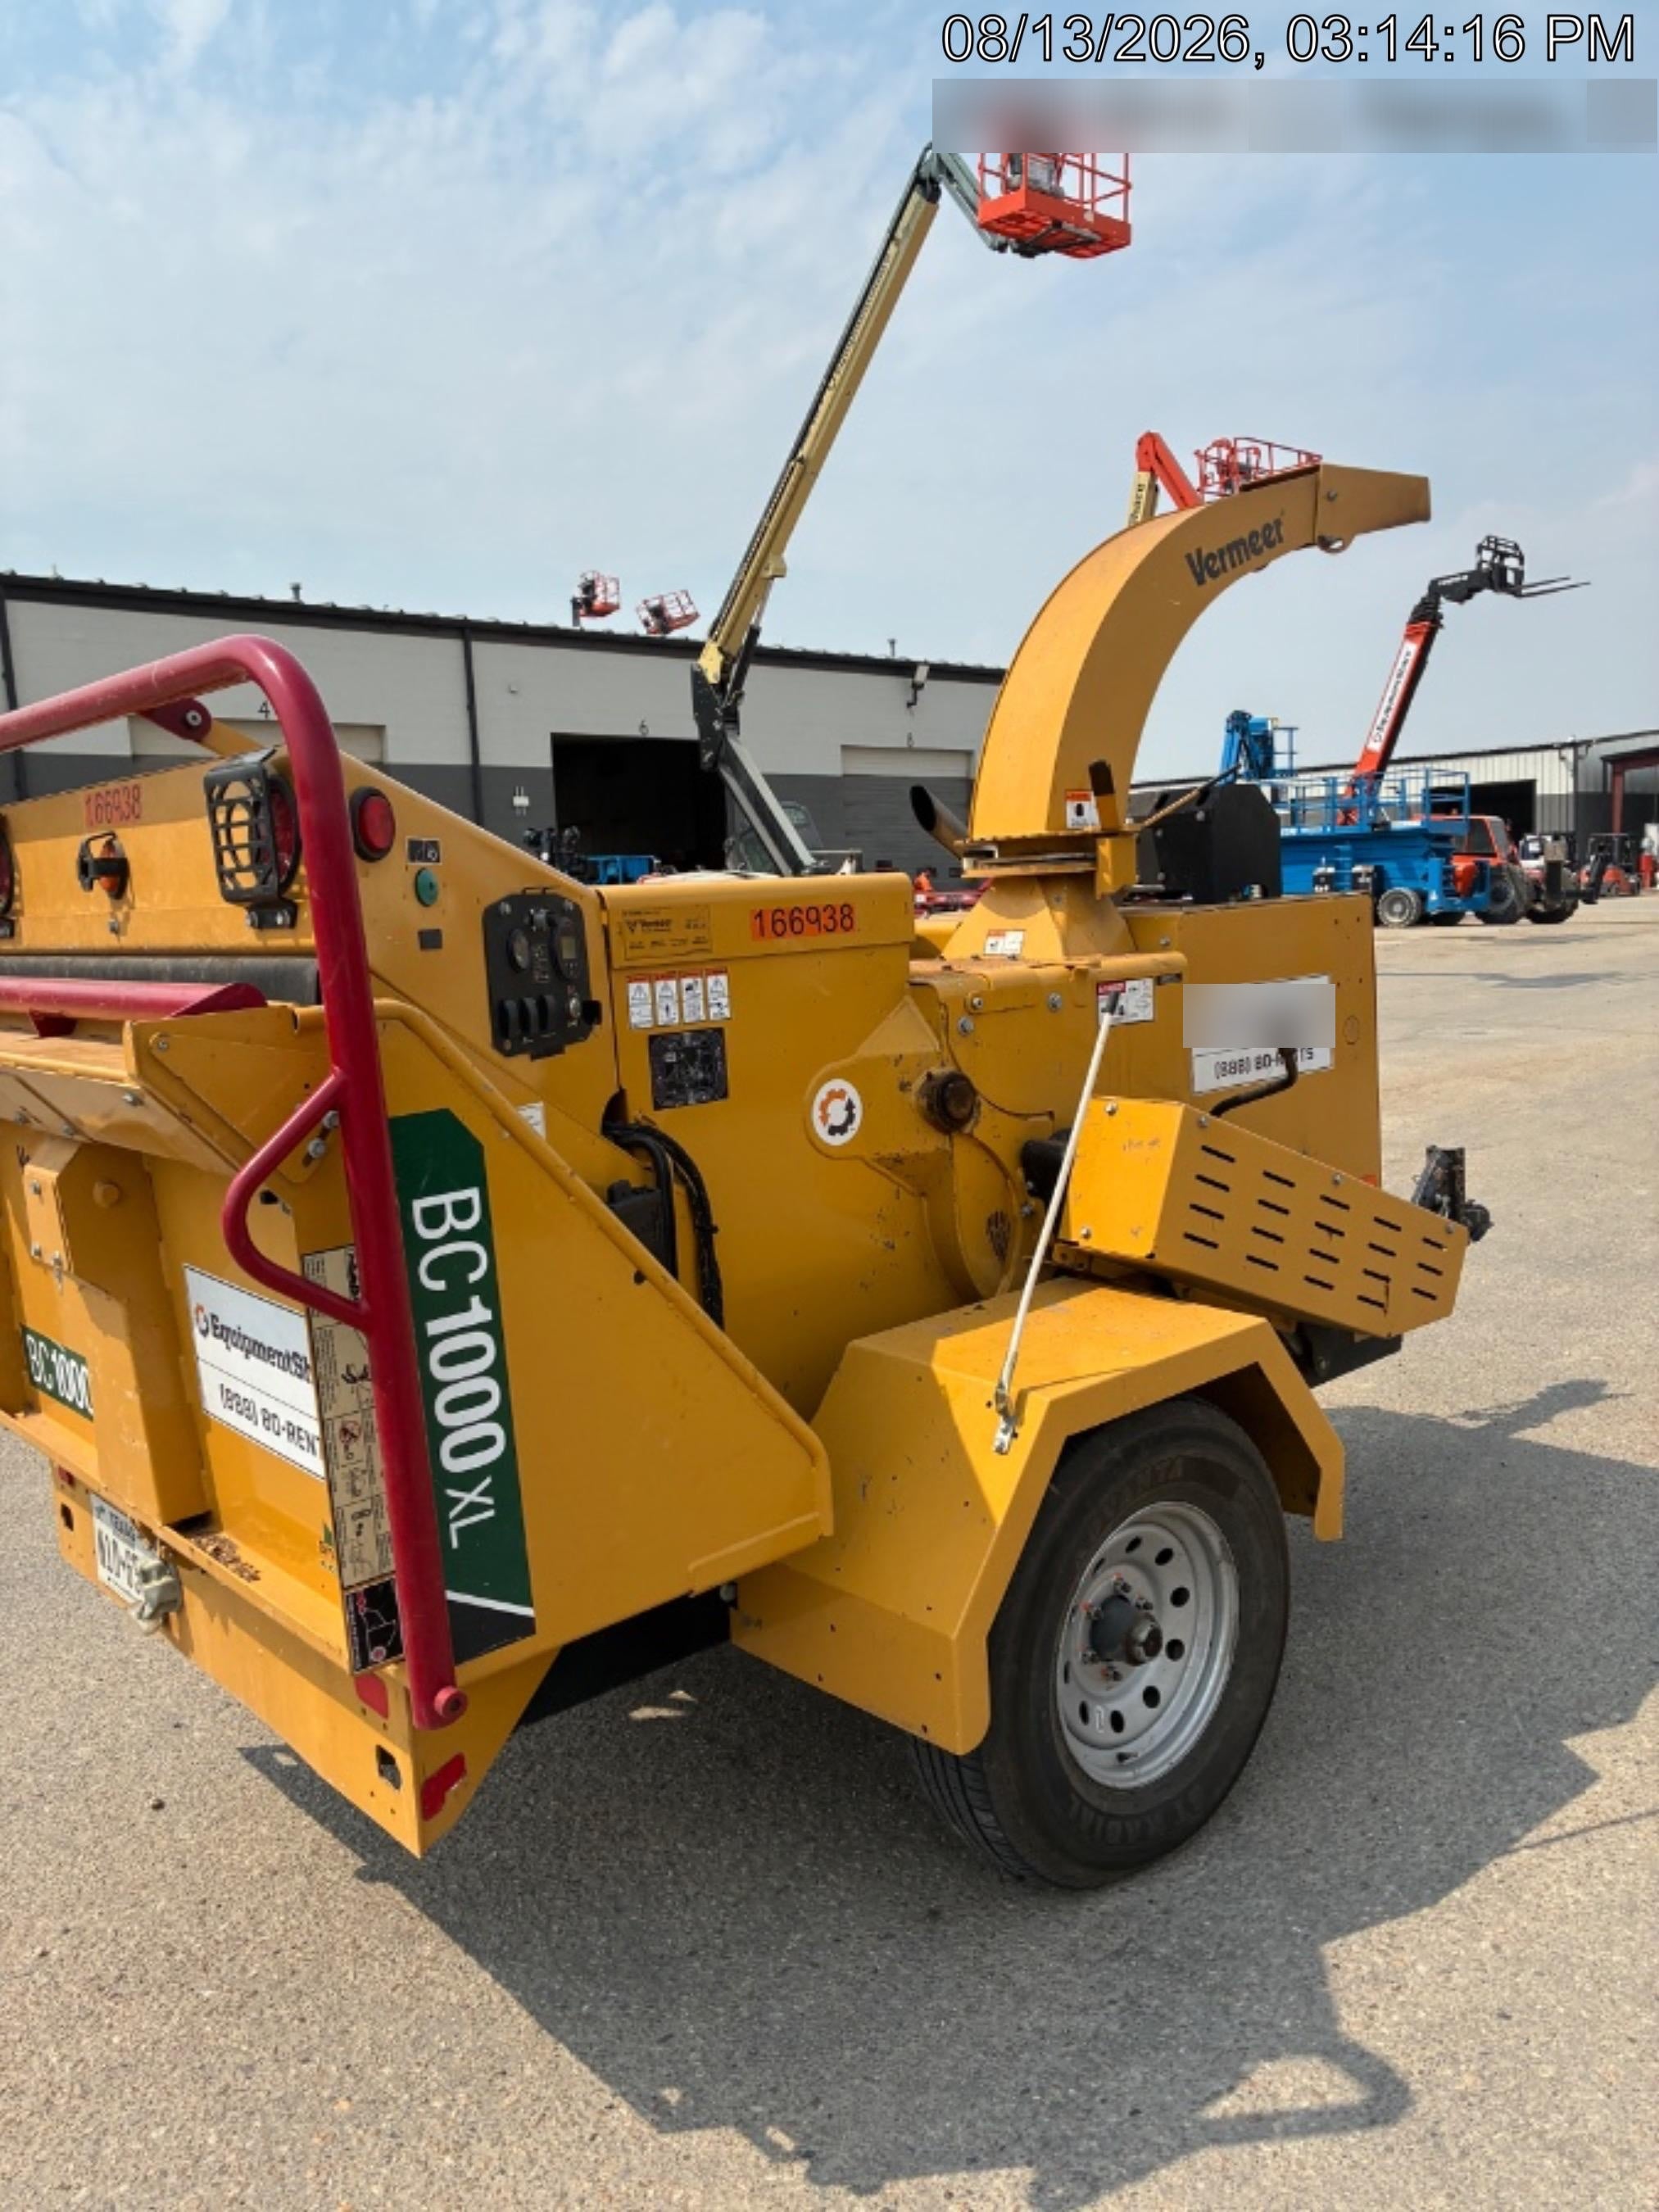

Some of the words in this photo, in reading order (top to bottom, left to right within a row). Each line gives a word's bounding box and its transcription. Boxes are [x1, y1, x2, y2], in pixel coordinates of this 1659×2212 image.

[1185, 518, 1284, 585] Vermeer
[257, 700, 270, 719] 4
[85, 783, 141, 827] 166938
[754, 904, 854, 937] 166938
